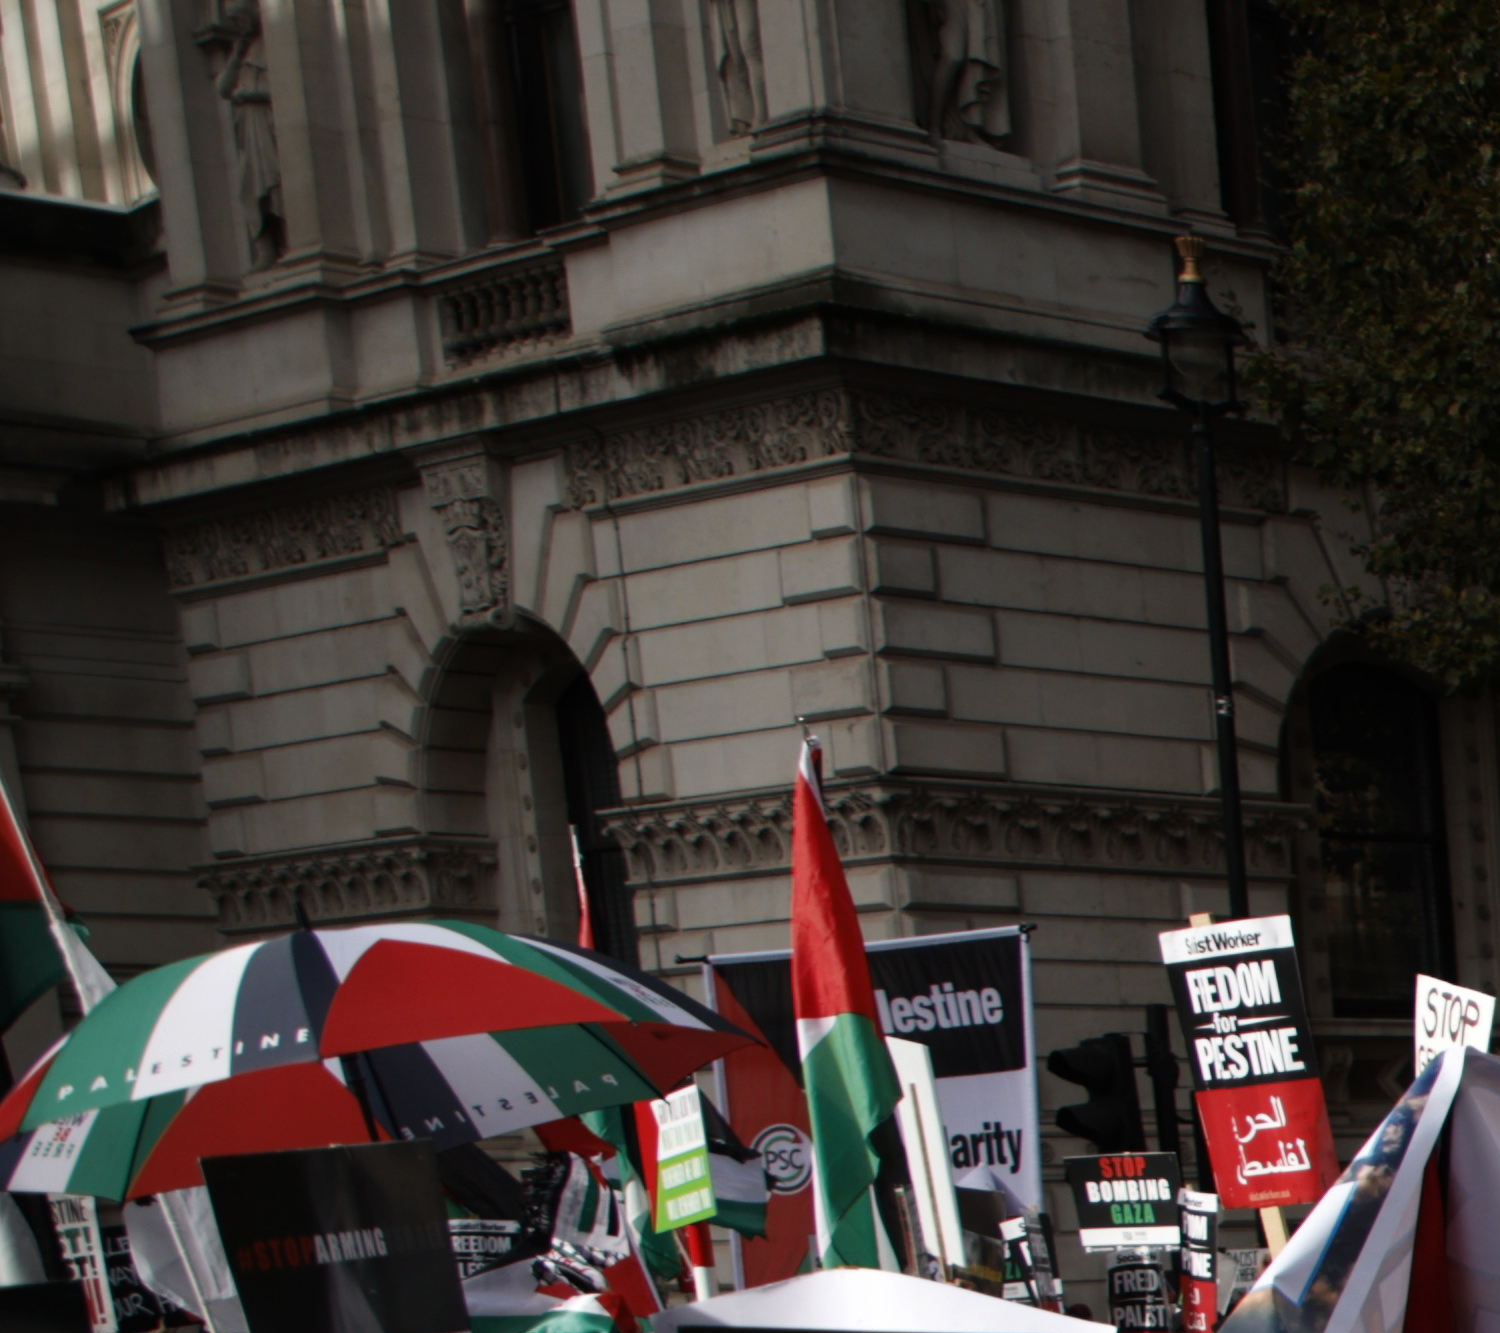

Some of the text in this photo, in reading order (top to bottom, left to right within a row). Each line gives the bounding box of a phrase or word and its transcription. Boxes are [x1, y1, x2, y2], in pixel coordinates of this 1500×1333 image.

[1212, 928, 1262, 952] Worker
[1212, 1011, 1238, 1035] for
[1420, 987, 1480, 1047] STOP
[58, 1027, 310, 1100] PALESTINE
[765, 1148, 804, 1173] PSC
[1099, 1156, 1148, 1179] STOP
[1085, 1178, 1172, 1204] BOMBING
[1111, 1203, 1157, 1225] GAZA
